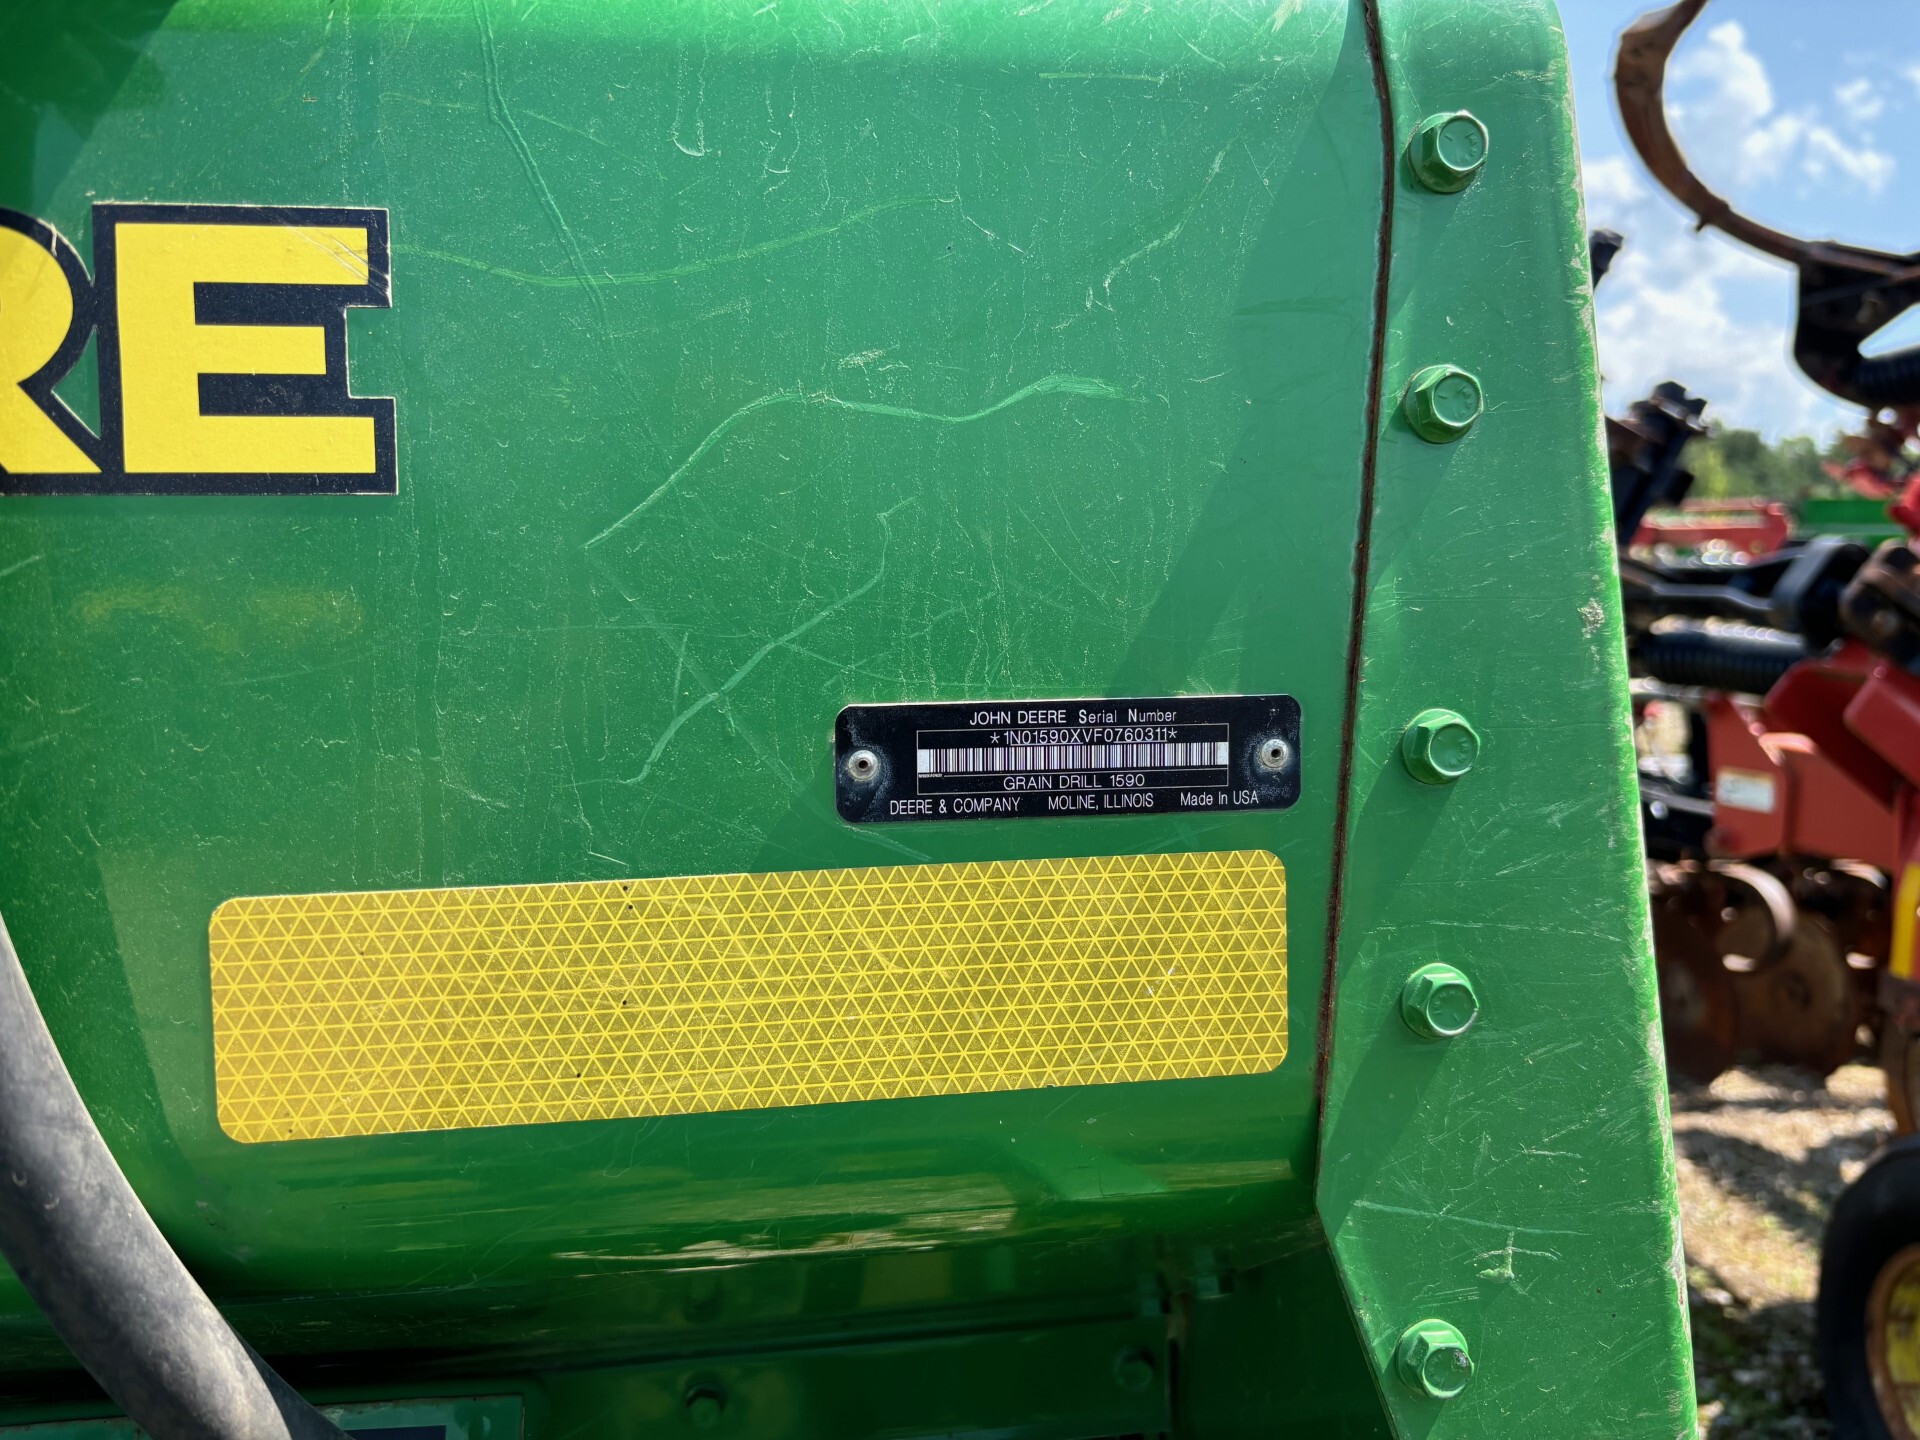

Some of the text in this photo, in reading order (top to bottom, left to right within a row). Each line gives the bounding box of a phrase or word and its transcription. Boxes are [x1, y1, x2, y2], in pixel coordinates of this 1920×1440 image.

[969, 708, 1177, 726] JOHN DEERE Serial Number
[1003, 773, 1145, 790] GRAIN DRILL 1590
[890, 799, 933, 815] DEERE
[938, 799, 948, 813] &
[953, 797, 1021, 813] COMPANY
[1048, 794, 1099, 810] MOLINE,
[1103, 793, 1154, 809] ILLINOIS
[1180, 792, 1213, 806] Made
[1232, 790, 1259, 805] USA
